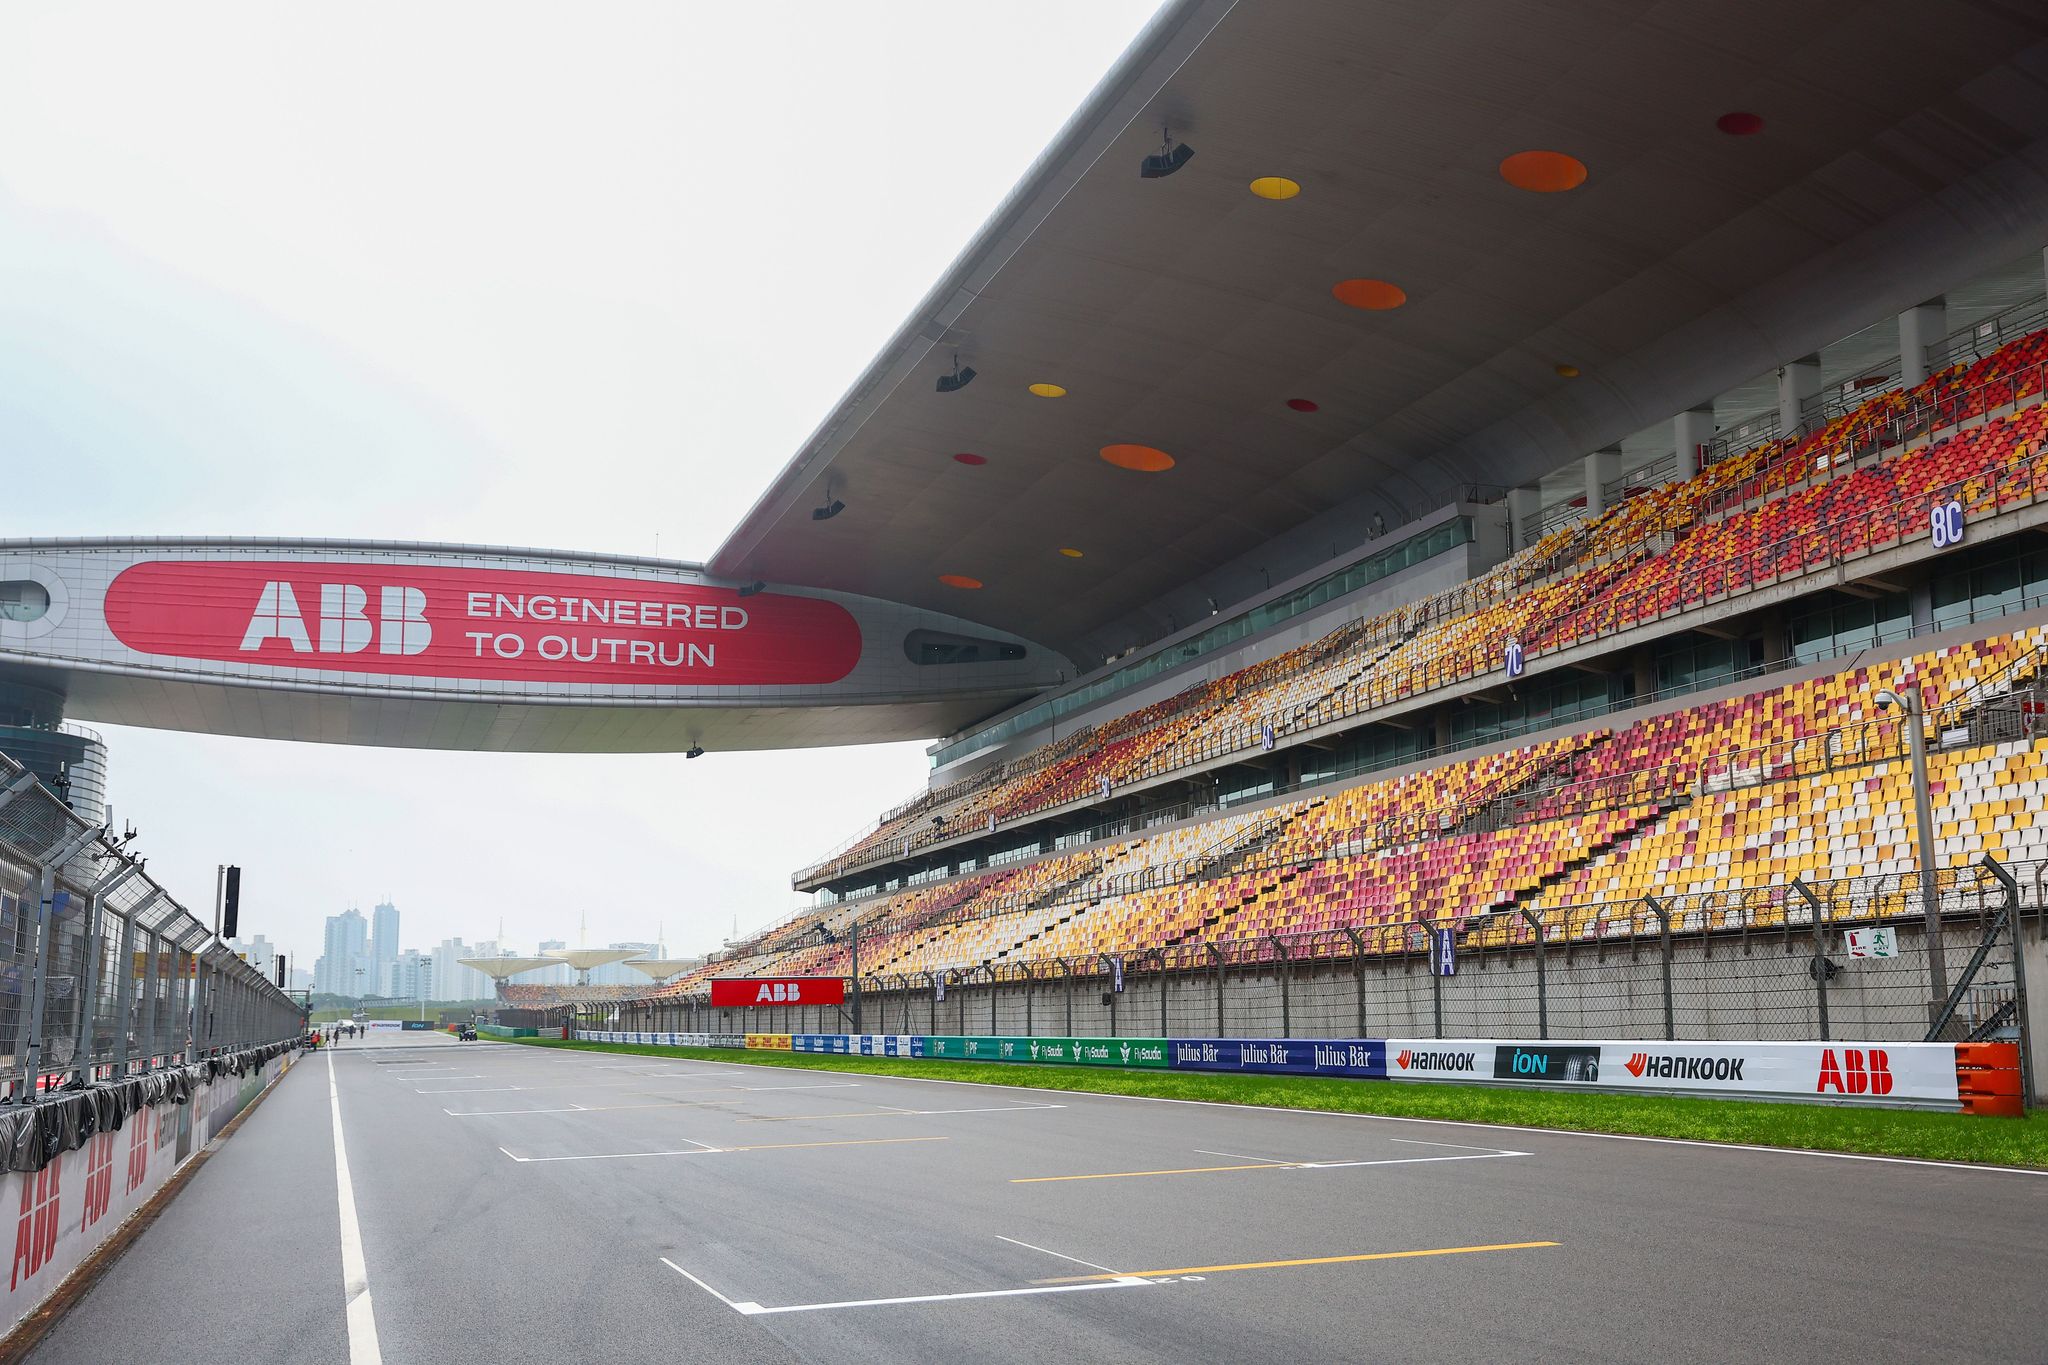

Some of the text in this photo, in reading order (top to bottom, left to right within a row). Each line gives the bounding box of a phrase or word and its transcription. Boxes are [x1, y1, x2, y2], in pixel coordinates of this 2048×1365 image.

[1931, 501, 1963, 548] 8C
[239, 581, 432, 656] ABB
[467, 592, 749, 630] ENGINEERED
[465, 631, 715, 667] TO OUTRUN
[1505, 644, 1522, 677] 7C
[755, 983, 801, 1002] ABB
[937, 1041, 945, 1054] PIF
[969, 1042, 978, 1055] PIF
[1004, 1043, 1014, 1057] PIF
[1177, 1043, 1219, 1064] Julius Bär
[1240, 1044, 1289, 1067] Julius Bär
[1314, 1045, 1371, 1070] Julius Bär
[1817, 1049, 1893, 1094] ABB
[81, 1132, 114, 1234] ABB
[11, 1155, 62, 1293] ABB
